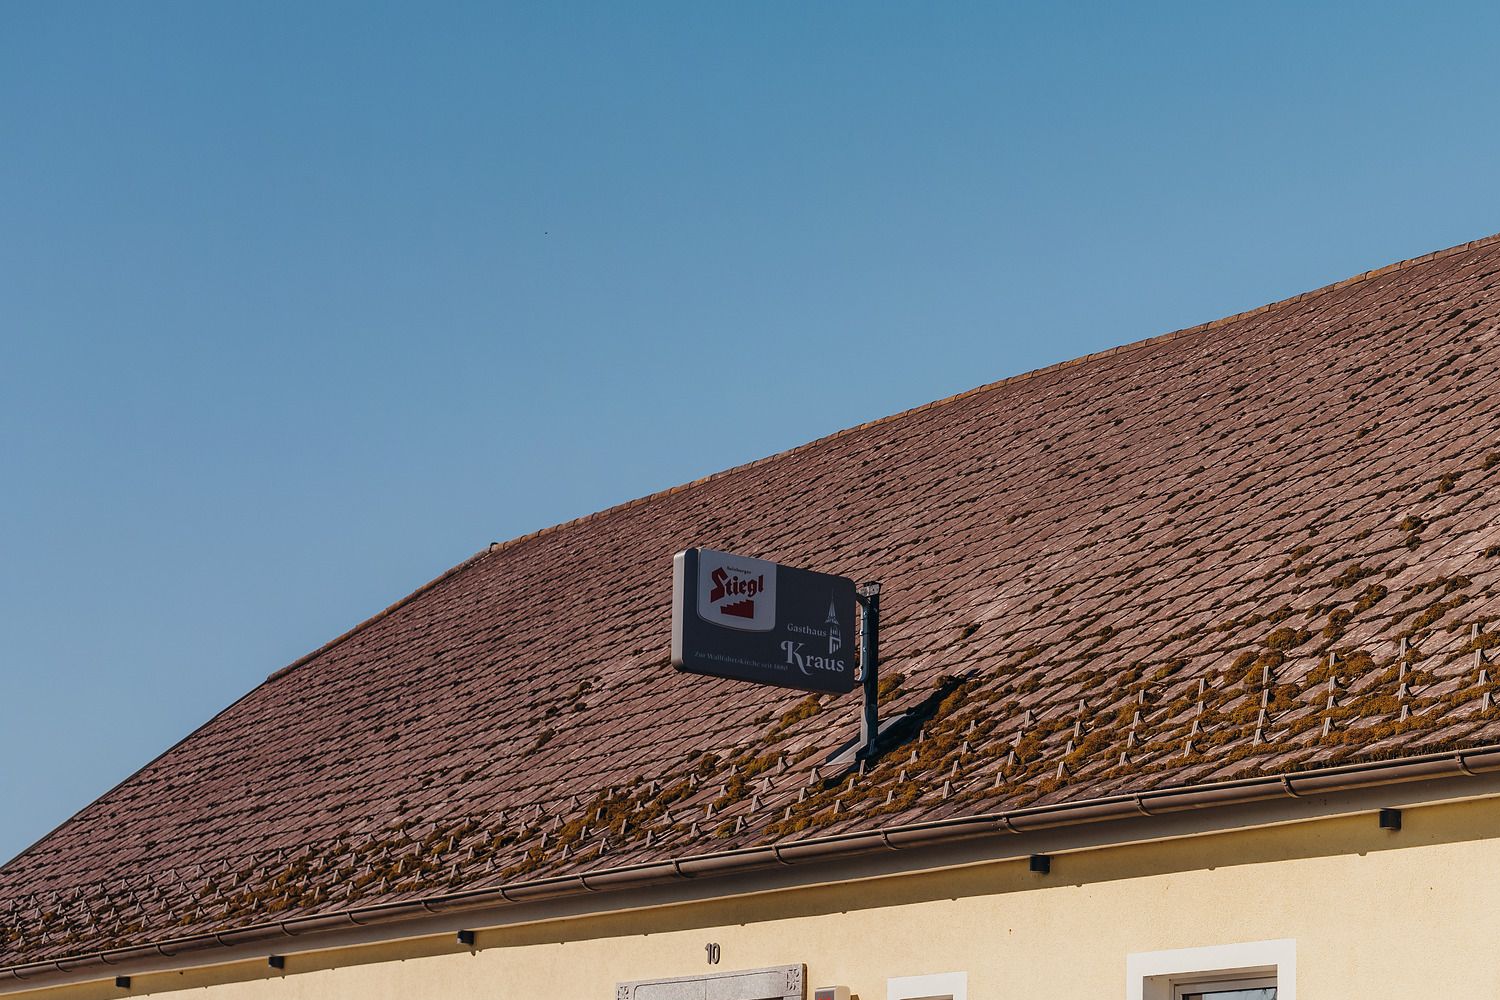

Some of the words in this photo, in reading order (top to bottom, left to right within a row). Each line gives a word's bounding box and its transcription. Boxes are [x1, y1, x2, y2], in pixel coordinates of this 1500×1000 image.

[711, 566, 764, 603] Stiegl
[787, 623, 828, 637] Gasthaus
[781, 640, 845, 676] Kraus
[705, 942, 720, 964] 10
